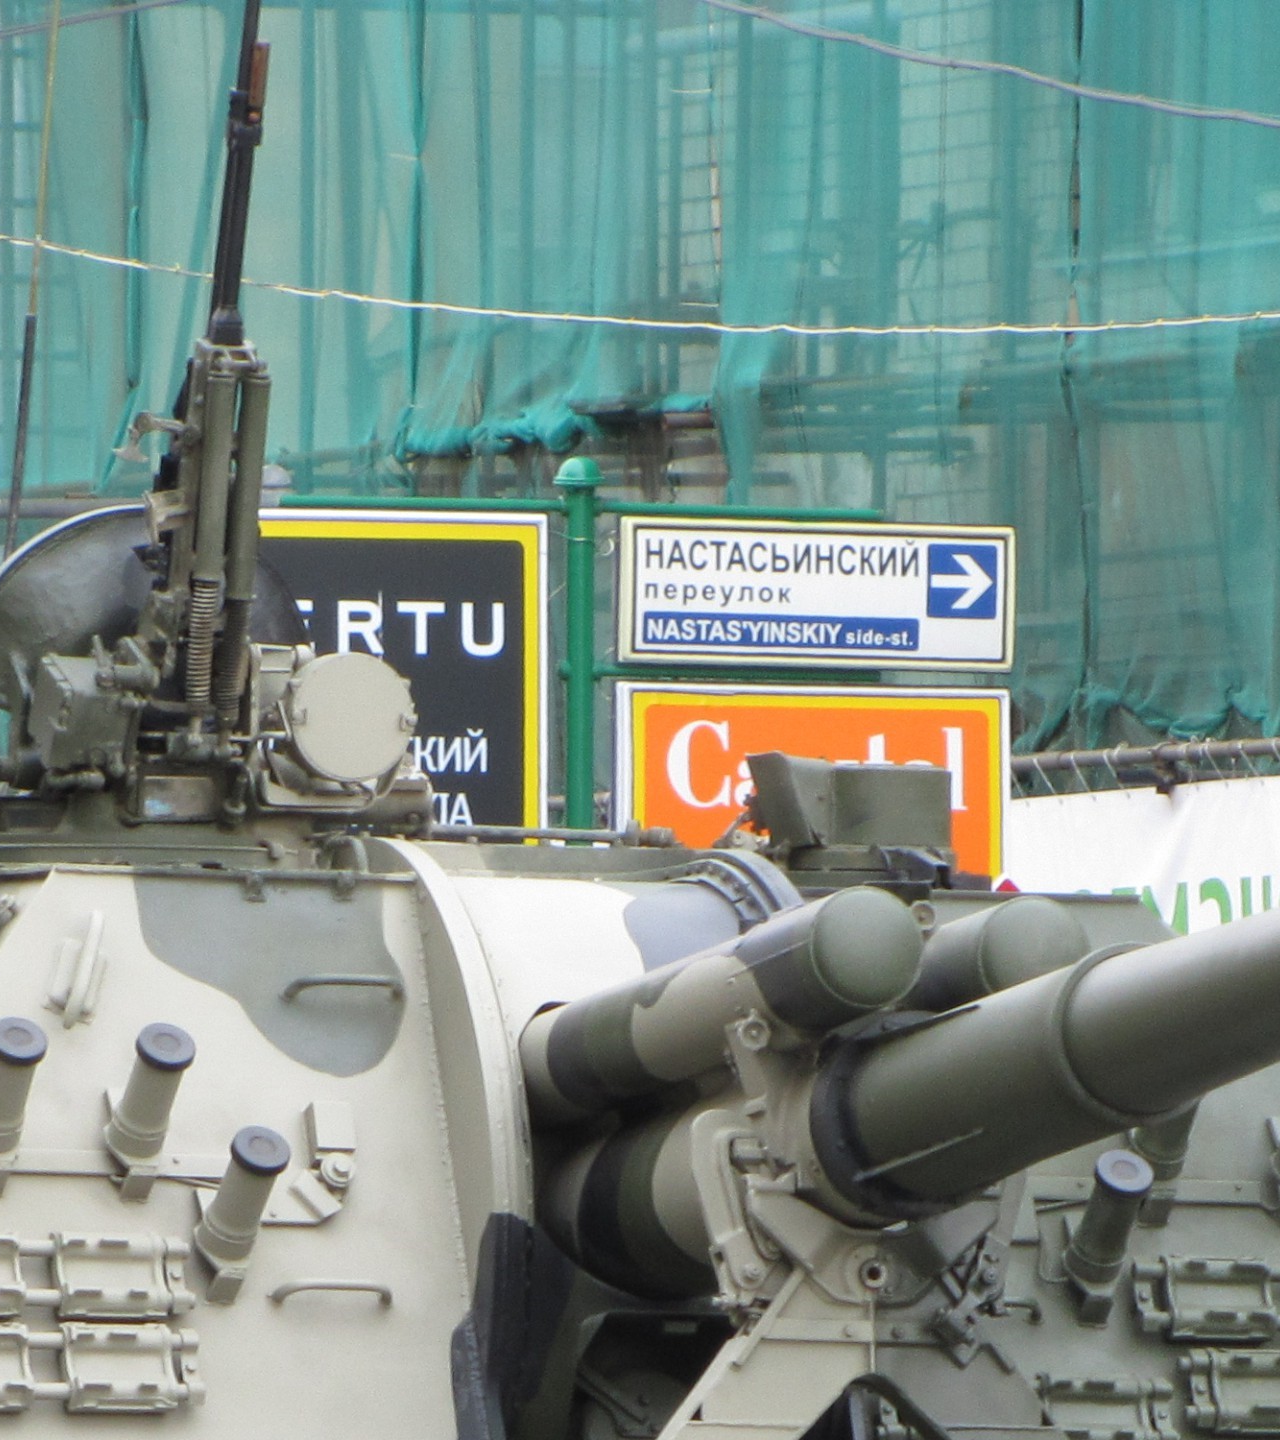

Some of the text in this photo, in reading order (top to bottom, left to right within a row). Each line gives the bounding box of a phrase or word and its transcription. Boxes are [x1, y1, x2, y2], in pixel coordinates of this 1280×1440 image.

[645, 539, 919, 578] НАСТАСЬИНСКИЙ
[644, 582, 791, 606] переулок
[647, 617, 913, 647] NASTAS'YINSKIY side-st.
